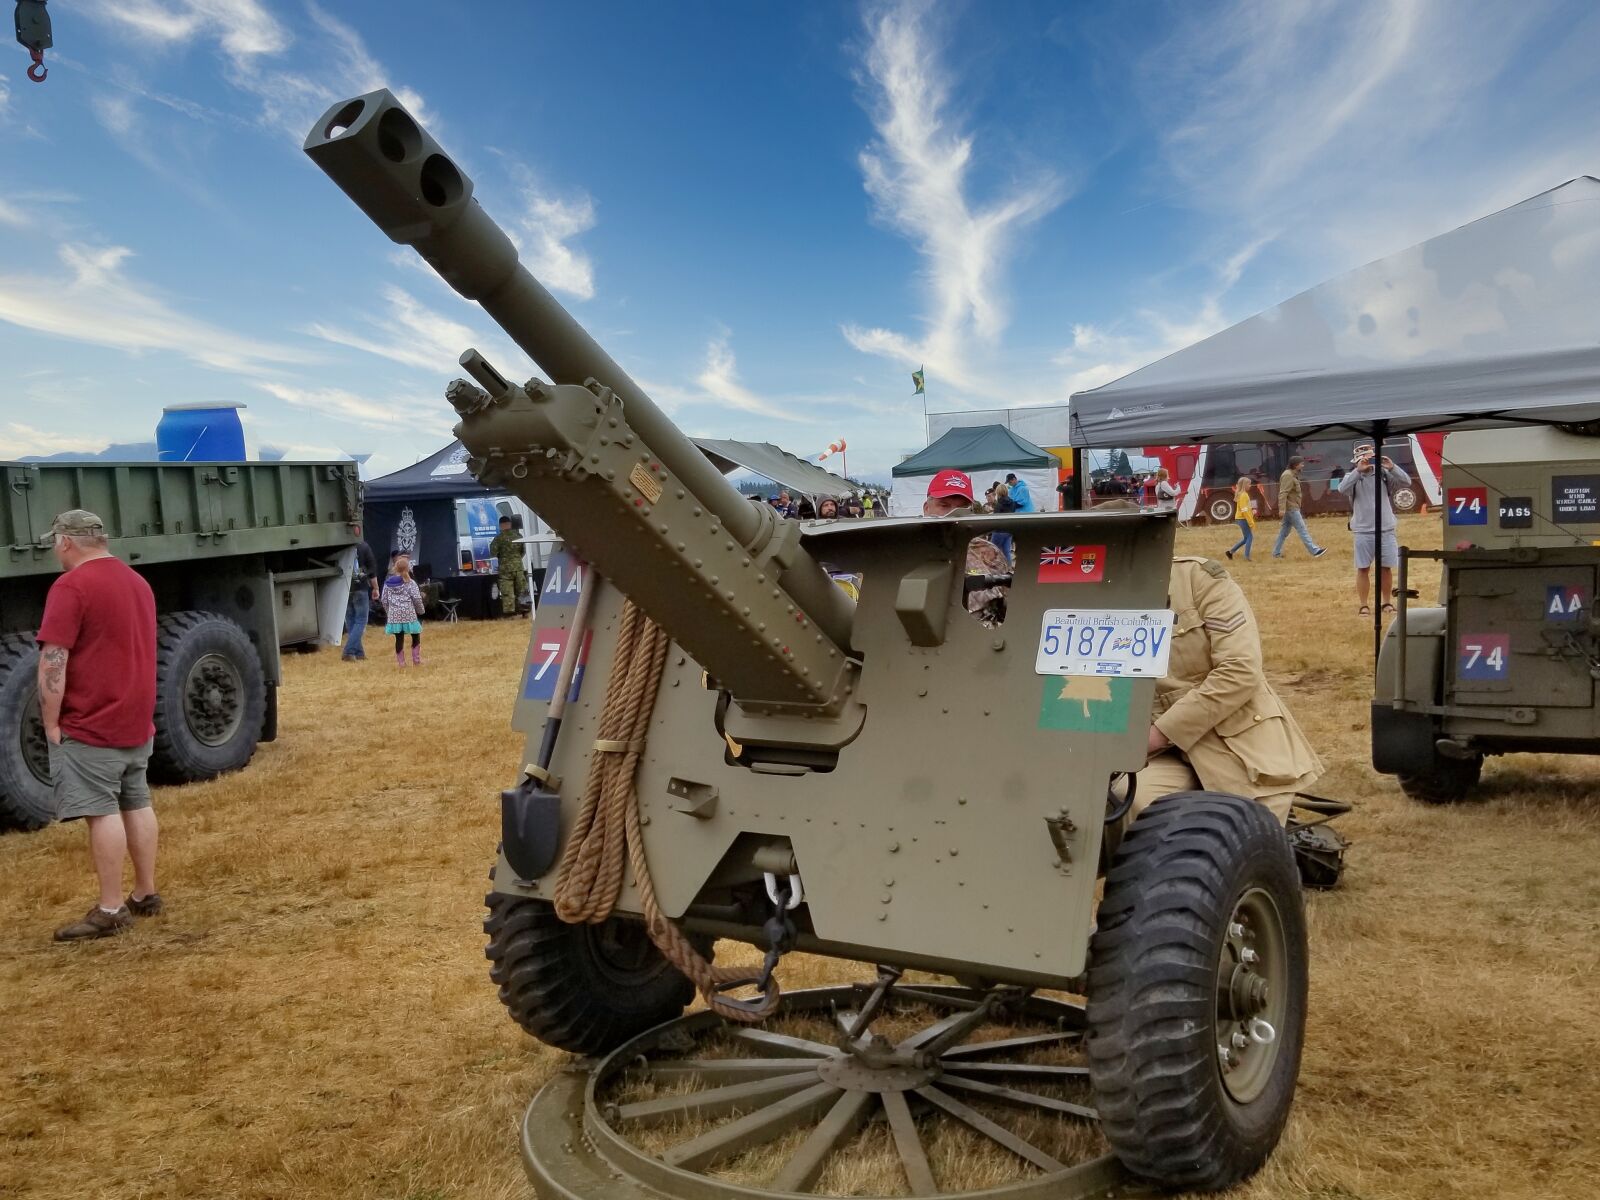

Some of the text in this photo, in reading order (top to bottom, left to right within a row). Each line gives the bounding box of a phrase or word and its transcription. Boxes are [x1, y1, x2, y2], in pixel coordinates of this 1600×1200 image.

[1455, 497, 1481, 514] 74
[1500, 507, 1531, 517] PASS
[546, 566, 582, 593] AA
[1549, 593, 1582, 613] AA
[1055, 616, 1162, 626] Beautiful British Columbia
[1043, 626, 1167, 658] 5187 8V
[1465, 645, 1504, 671] 74
